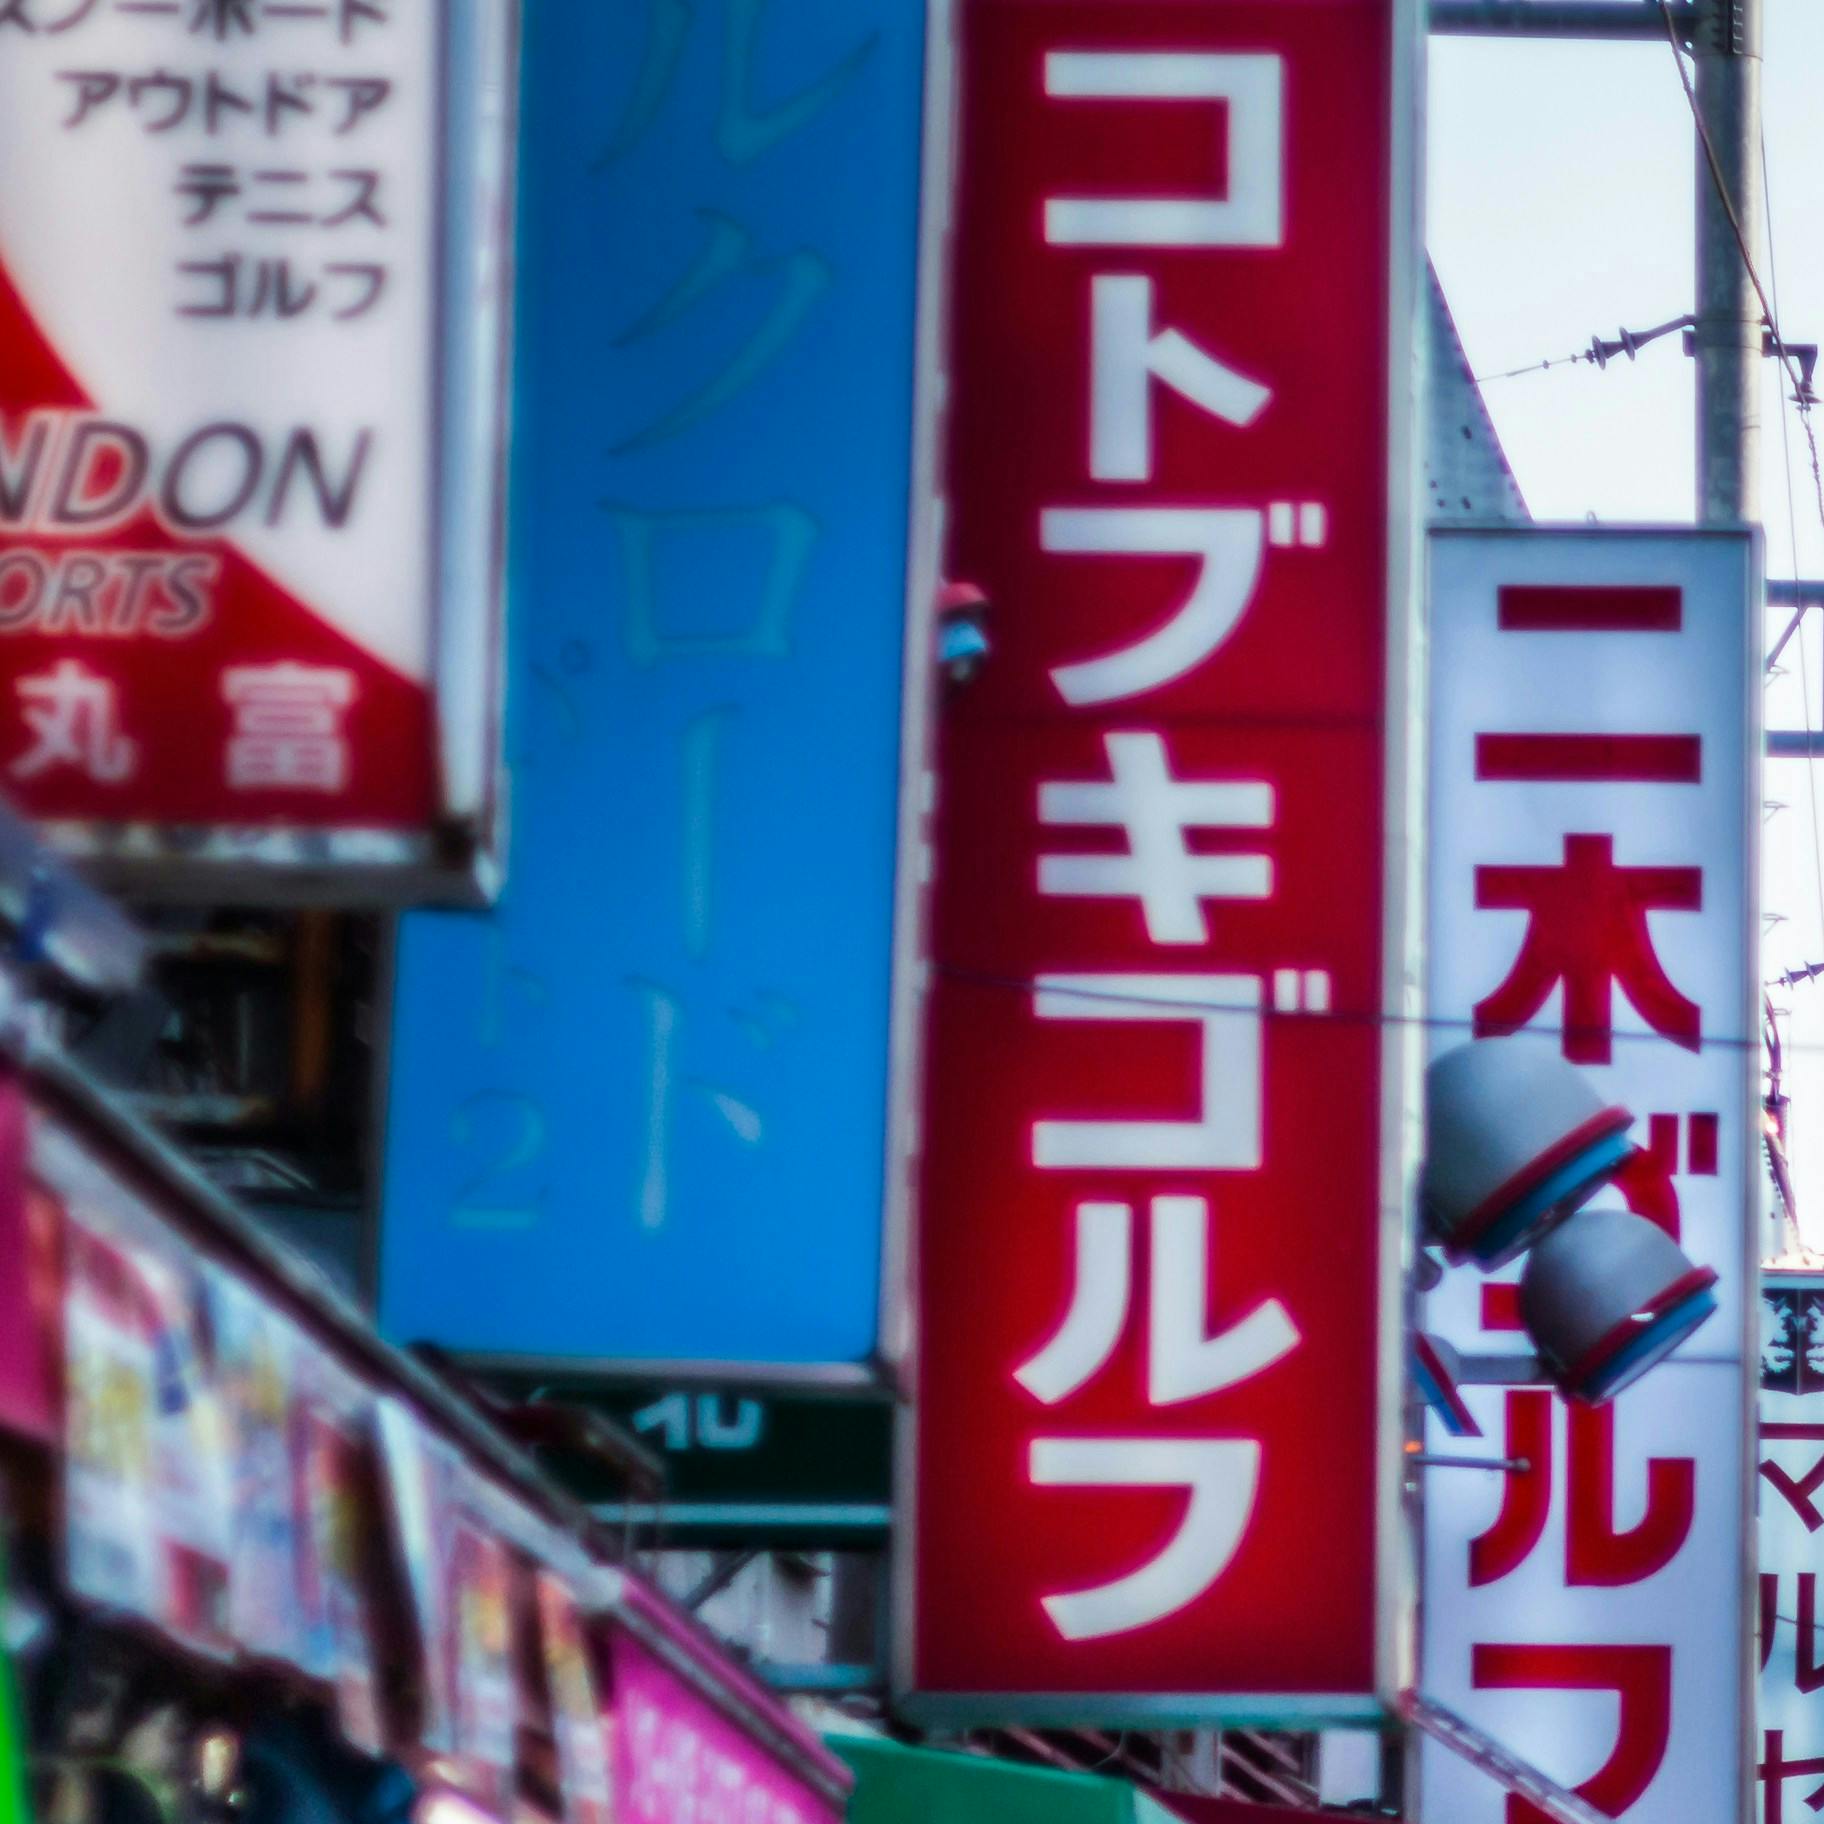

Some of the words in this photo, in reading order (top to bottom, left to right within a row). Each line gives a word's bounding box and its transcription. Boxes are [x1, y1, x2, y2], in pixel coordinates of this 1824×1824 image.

[54, 69, 391, 136] アウトドア
[174, 162, 388, 228] テニス
[174, 250, 388, 321] ゴルフ
[1011, 52, 1331, 1641] コトブキゴルフ
